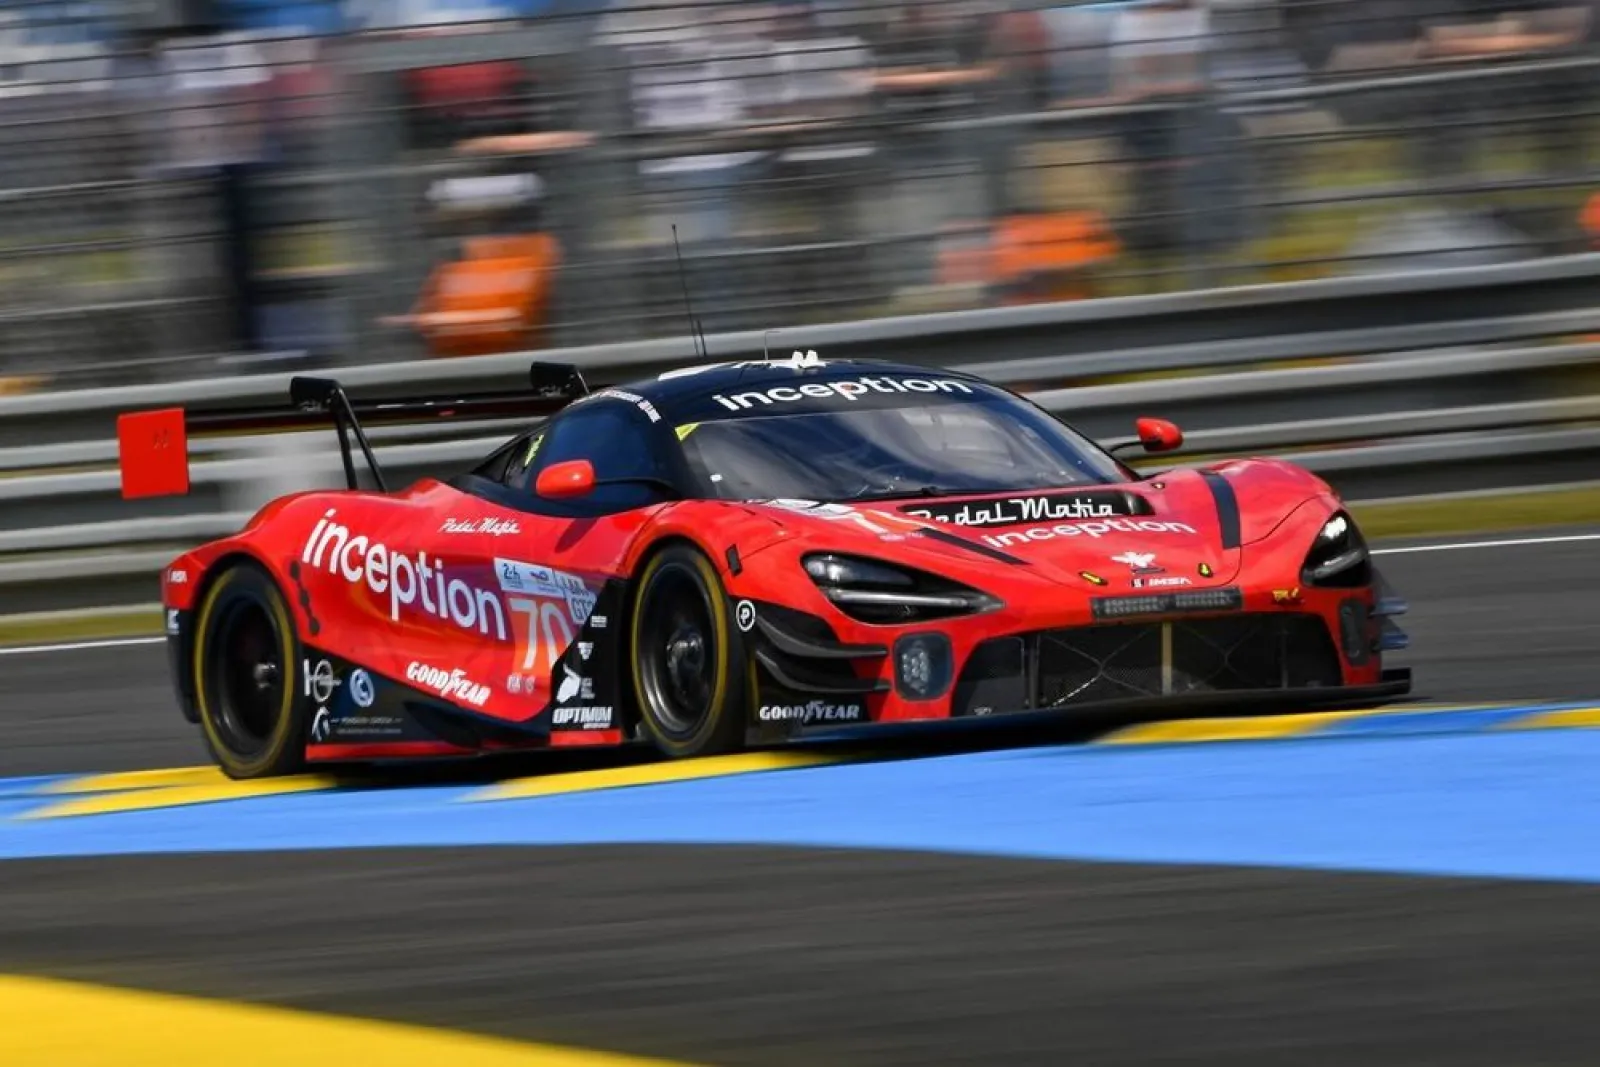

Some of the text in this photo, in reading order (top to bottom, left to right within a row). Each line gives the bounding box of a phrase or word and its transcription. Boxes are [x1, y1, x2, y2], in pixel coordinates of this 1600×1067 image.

[712, 377, 973, 411] inception
[984, 518, 1196, 548] inception
[302, 508, 506, 640] inception
[508, 598, 574, 670] 70
[406, 661, 491, 707] GOODYEAR
[552, 706, 614, 724] OPTIMUM
[759, 700, 860, 724] GOODYEAR
